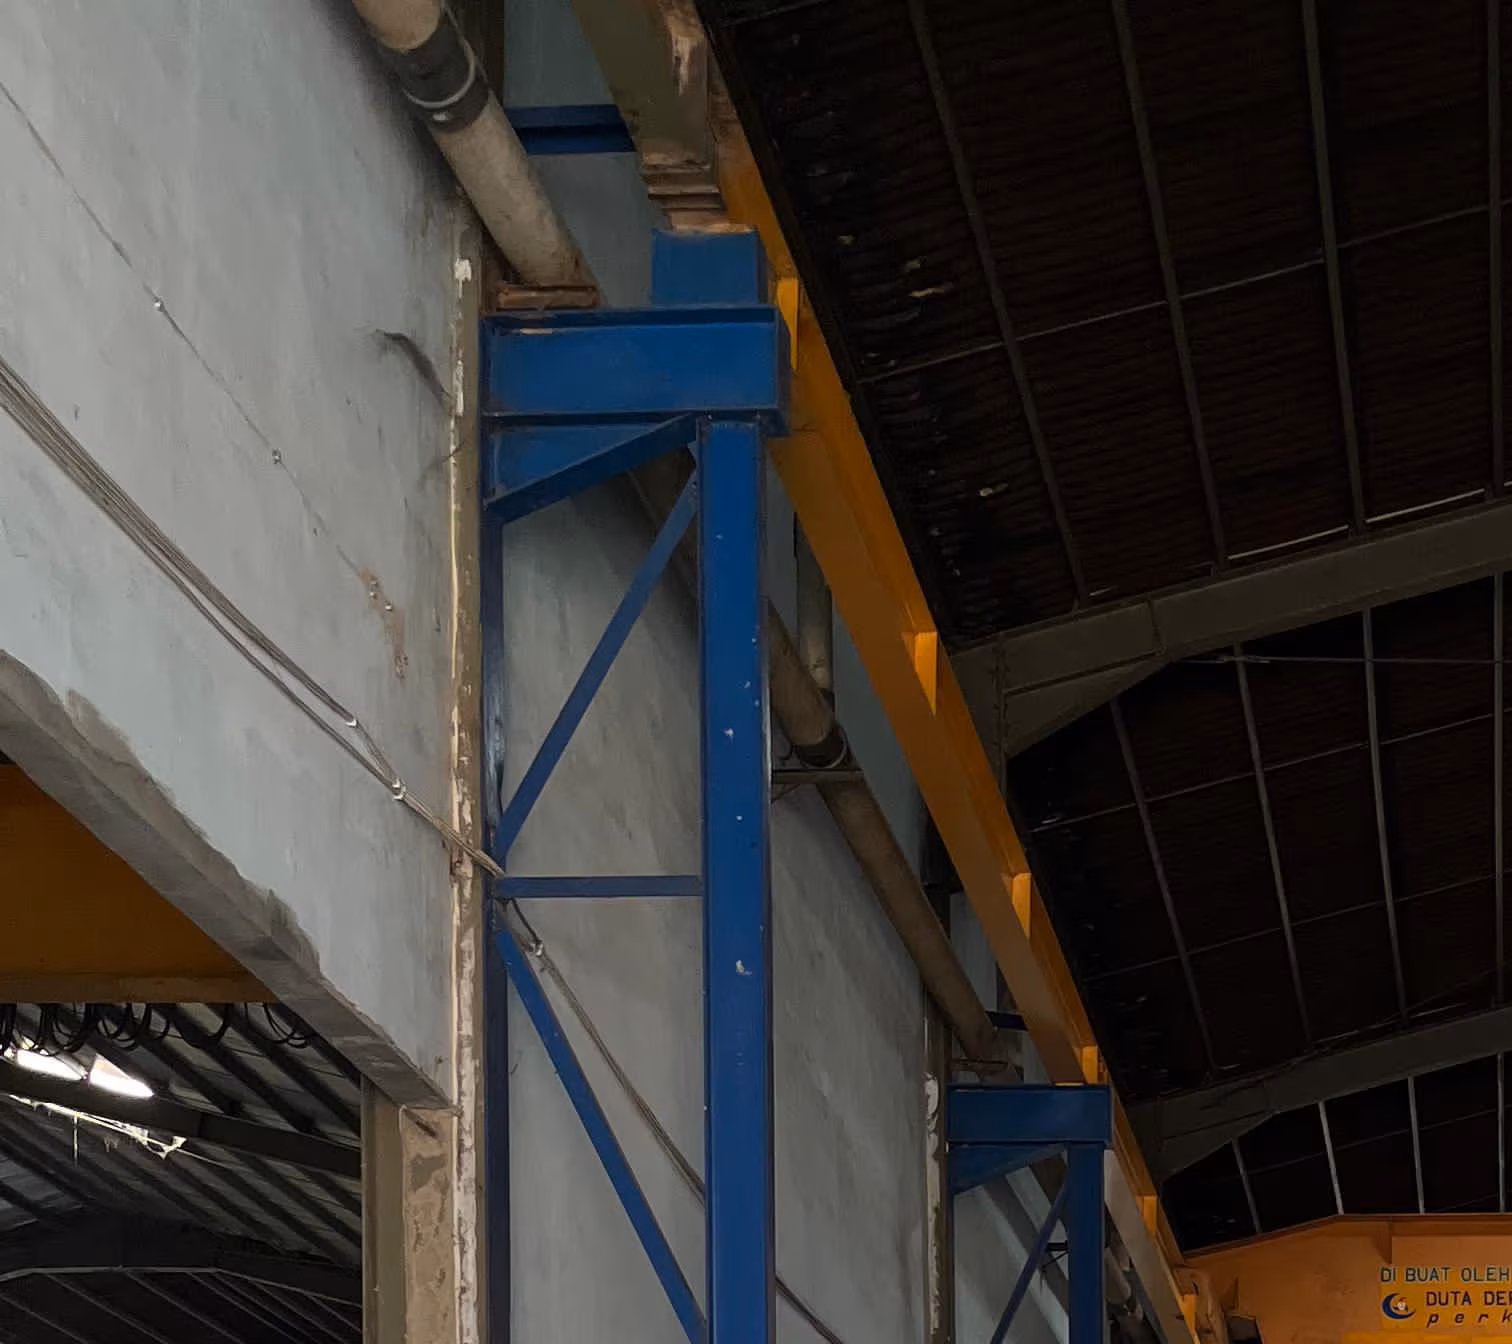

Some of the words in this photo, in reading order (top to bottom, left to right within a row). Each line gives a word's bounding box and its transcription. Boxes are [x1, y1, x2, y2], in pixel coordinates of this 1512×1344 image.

[1380, 1267, 1396, 1283] DI
[1405, 1267, 1450, 1282] BUAT
[1461, 1266, 1510, 1282] OLEH
[1425, 1291, 1472, 1306] DUTA
